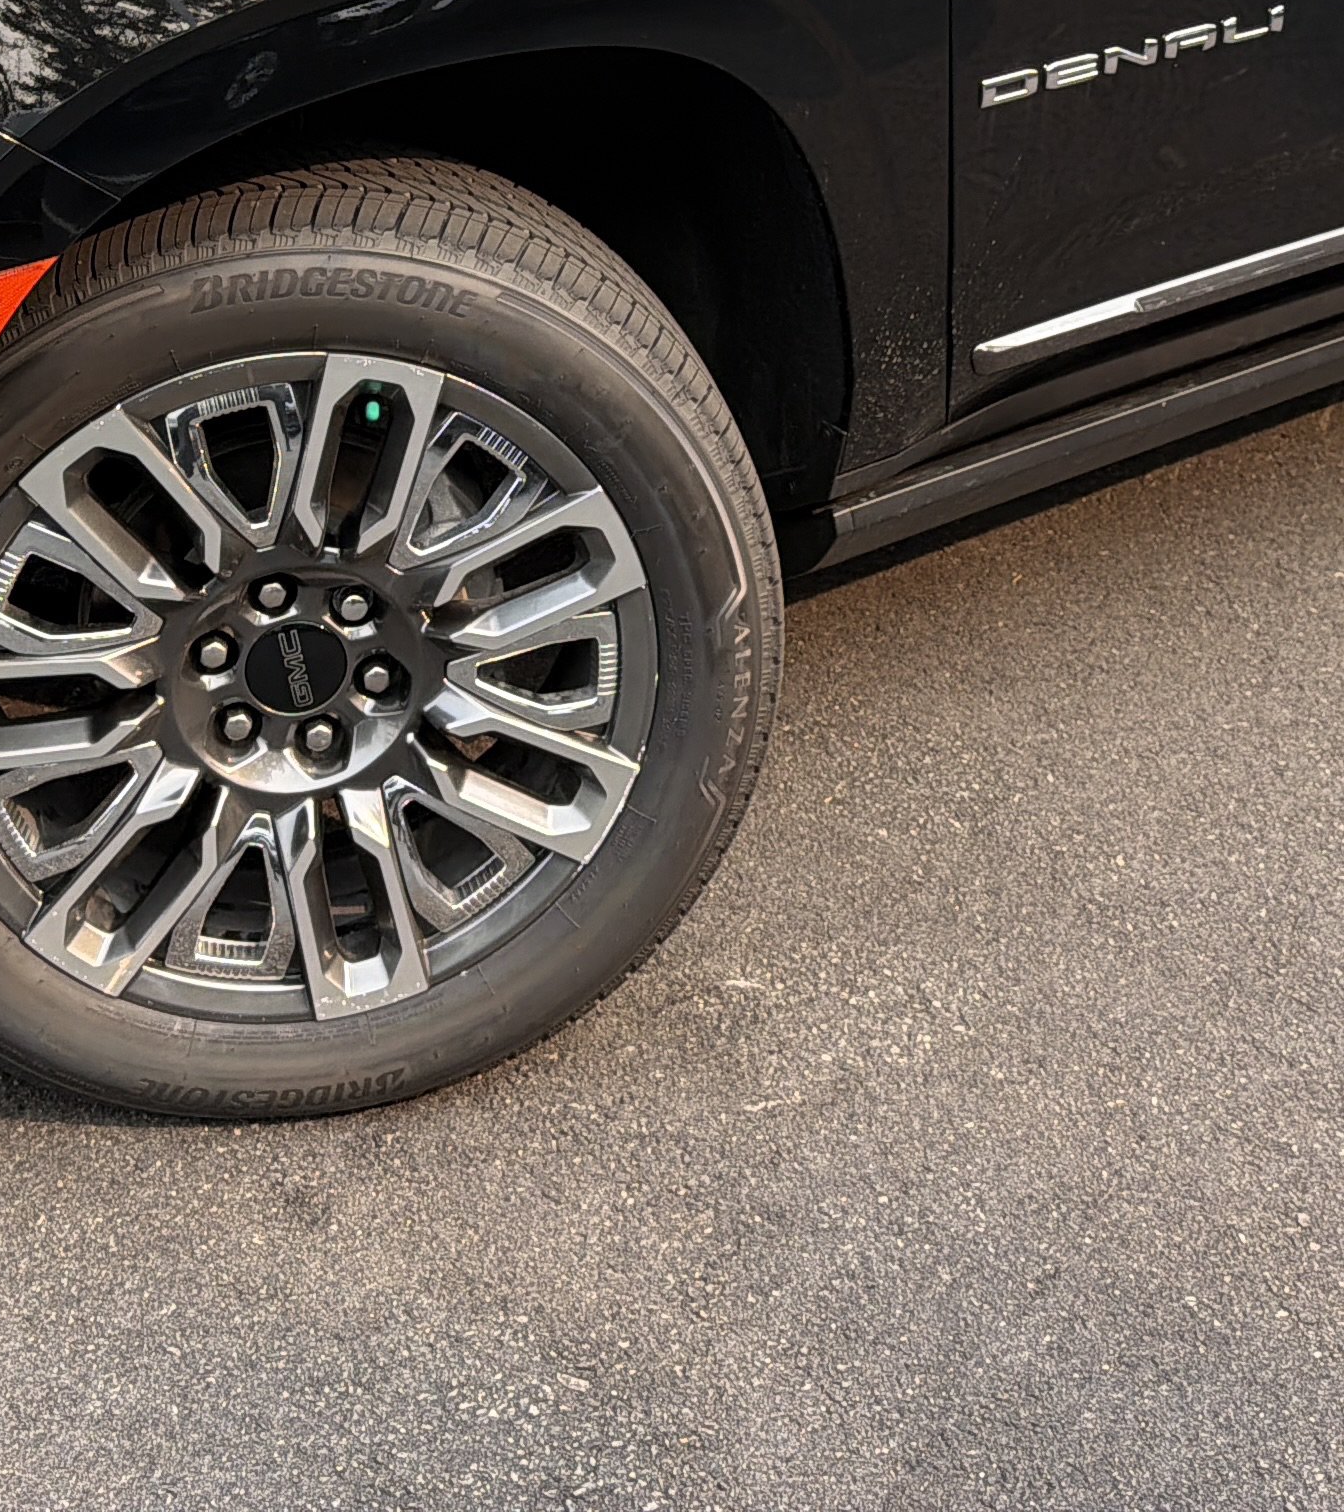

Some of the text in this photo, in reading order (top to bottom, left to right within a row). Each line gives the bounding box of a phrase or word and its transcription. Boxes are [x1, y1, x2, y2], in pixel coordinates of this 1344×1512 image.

[981, 4, 1285, 109] DENALI
[190, 266, 482, 319] BRIDGESTONE
[277, 629, 314, 708] GMC
[718, 624, 752, 775] ALENZA
[138, 1066, 407, 1113] BRIDGESTONE
